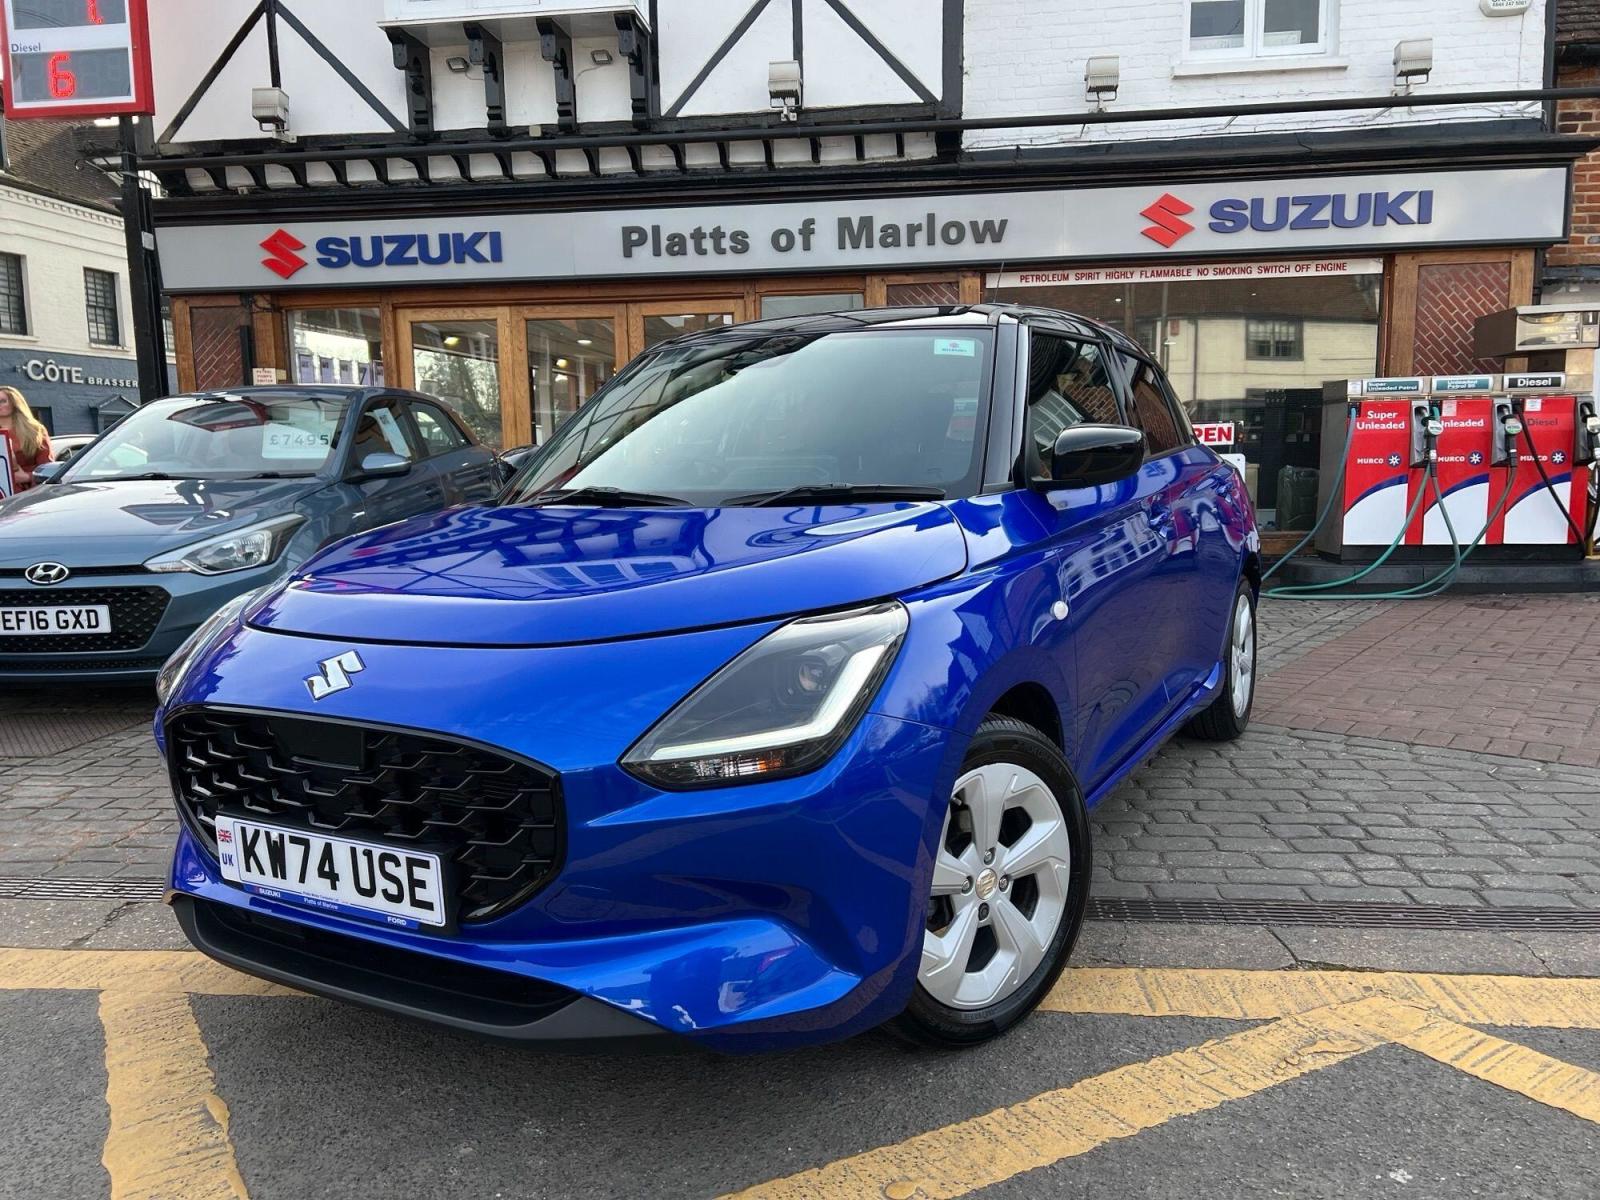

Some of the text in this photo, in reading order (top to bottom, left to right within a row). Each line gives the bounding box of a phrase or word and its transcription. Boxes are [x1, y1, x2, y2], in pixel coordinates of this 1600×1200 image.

[11, 43, 41, 53] Diesel
[48, 50, 76, 98] 6
[1208, 190, 1434, 234] SUZUKI
[621, 213, 1008, 258] Platts of Marlow
[315, 231, 503, 269] SUZUKI
[1020, 262, 1347, 283] PETROLEUM SPIRIT HIGHLY FLAMMABLE NO SMOKING SWITCH OFF ENGINE
[27, 359, 83, 383] CÔTE
[1517, 377, 1552, 387] Diesel
[1367, 410, 1398, 419] Super
[1356, 421, 1405, 430] Unleaded
[1527, 417, 1558, 426] Diesel
[270, 433, 329, 446] £7495
[1437, 455, 1465, 463] MURCO
[1520, 454, 1548, 462] MUCO
[1, 609, 99, 631] EF16 GXD
[221, 852, 234, 867] UK
[240, 826, 434, 912] KW74 USE
[259, 887, 281, 898] SUZUKI
[387, 916, 407, 926] FORD
